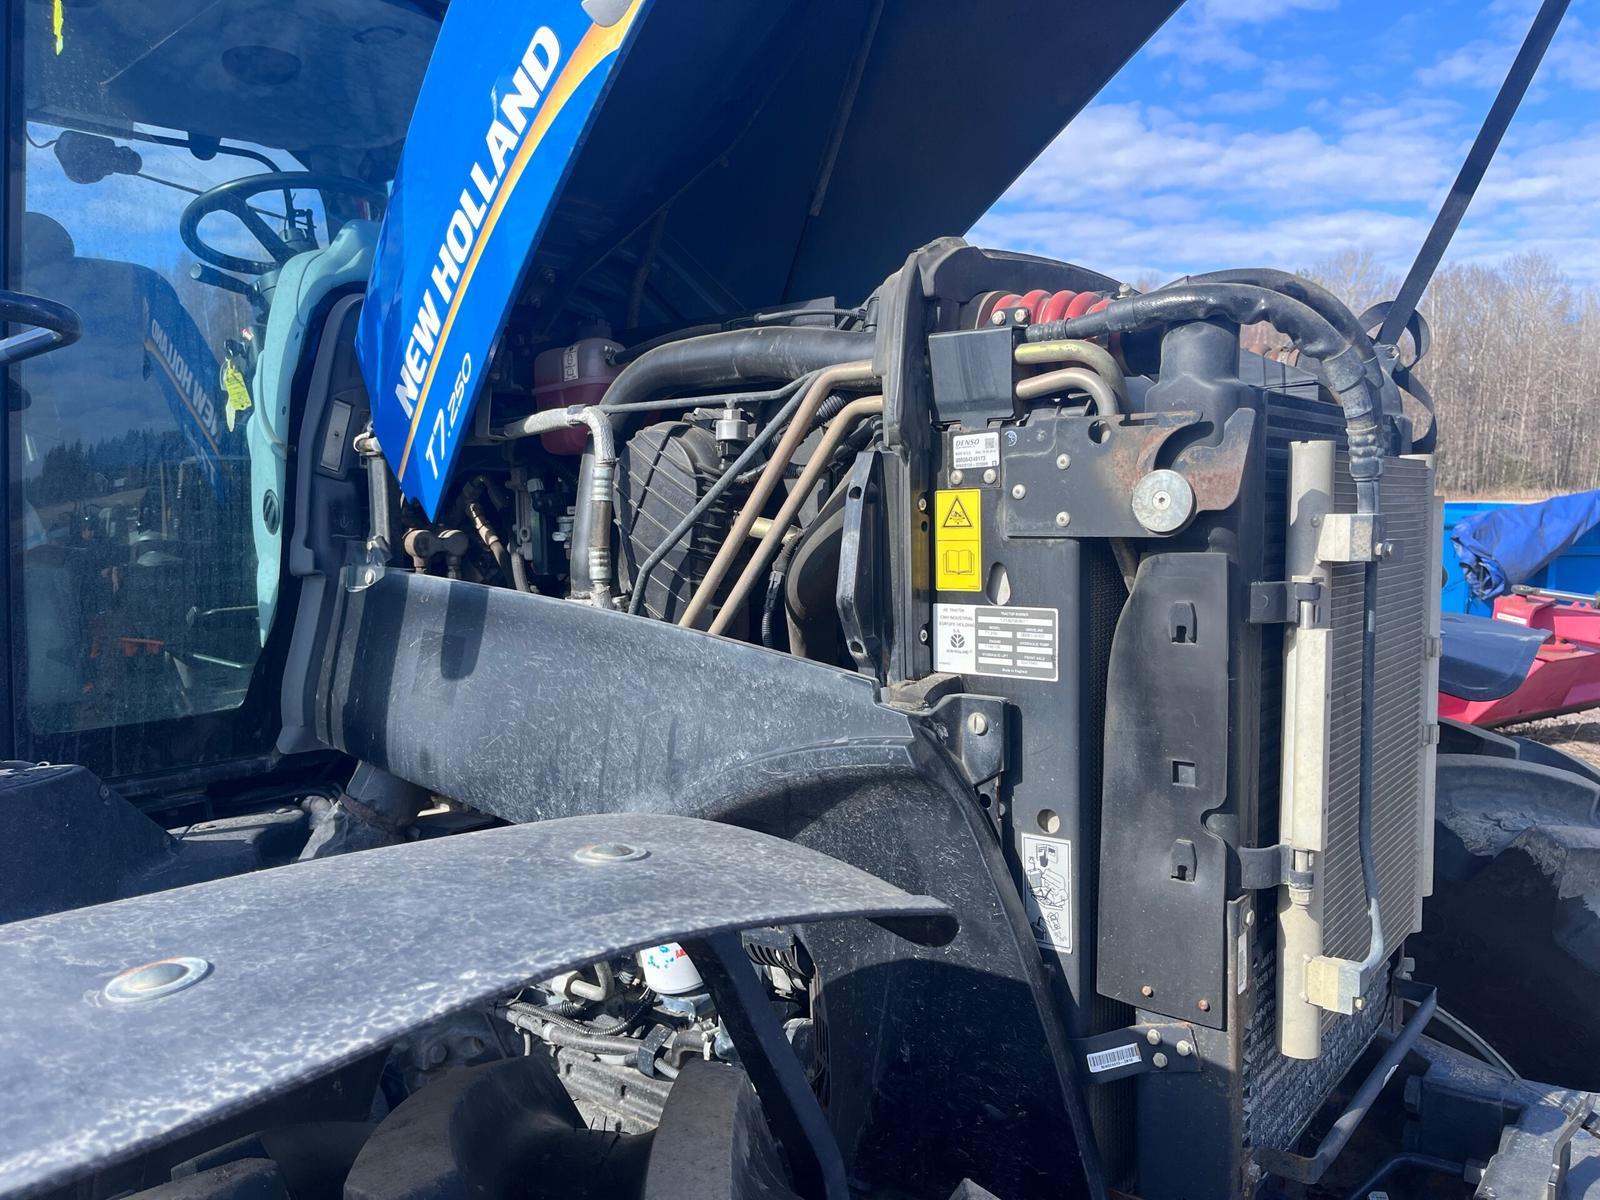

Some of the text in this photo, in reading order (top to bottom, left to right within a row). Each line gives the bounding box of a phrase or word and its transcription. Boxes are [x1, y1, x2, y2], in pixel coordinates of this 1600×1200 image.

[394, 25, 561, 420] NEW HOLLAND
[425, 352, 472, 481] T7.250
[955, 438, 980, 447] DENSO
